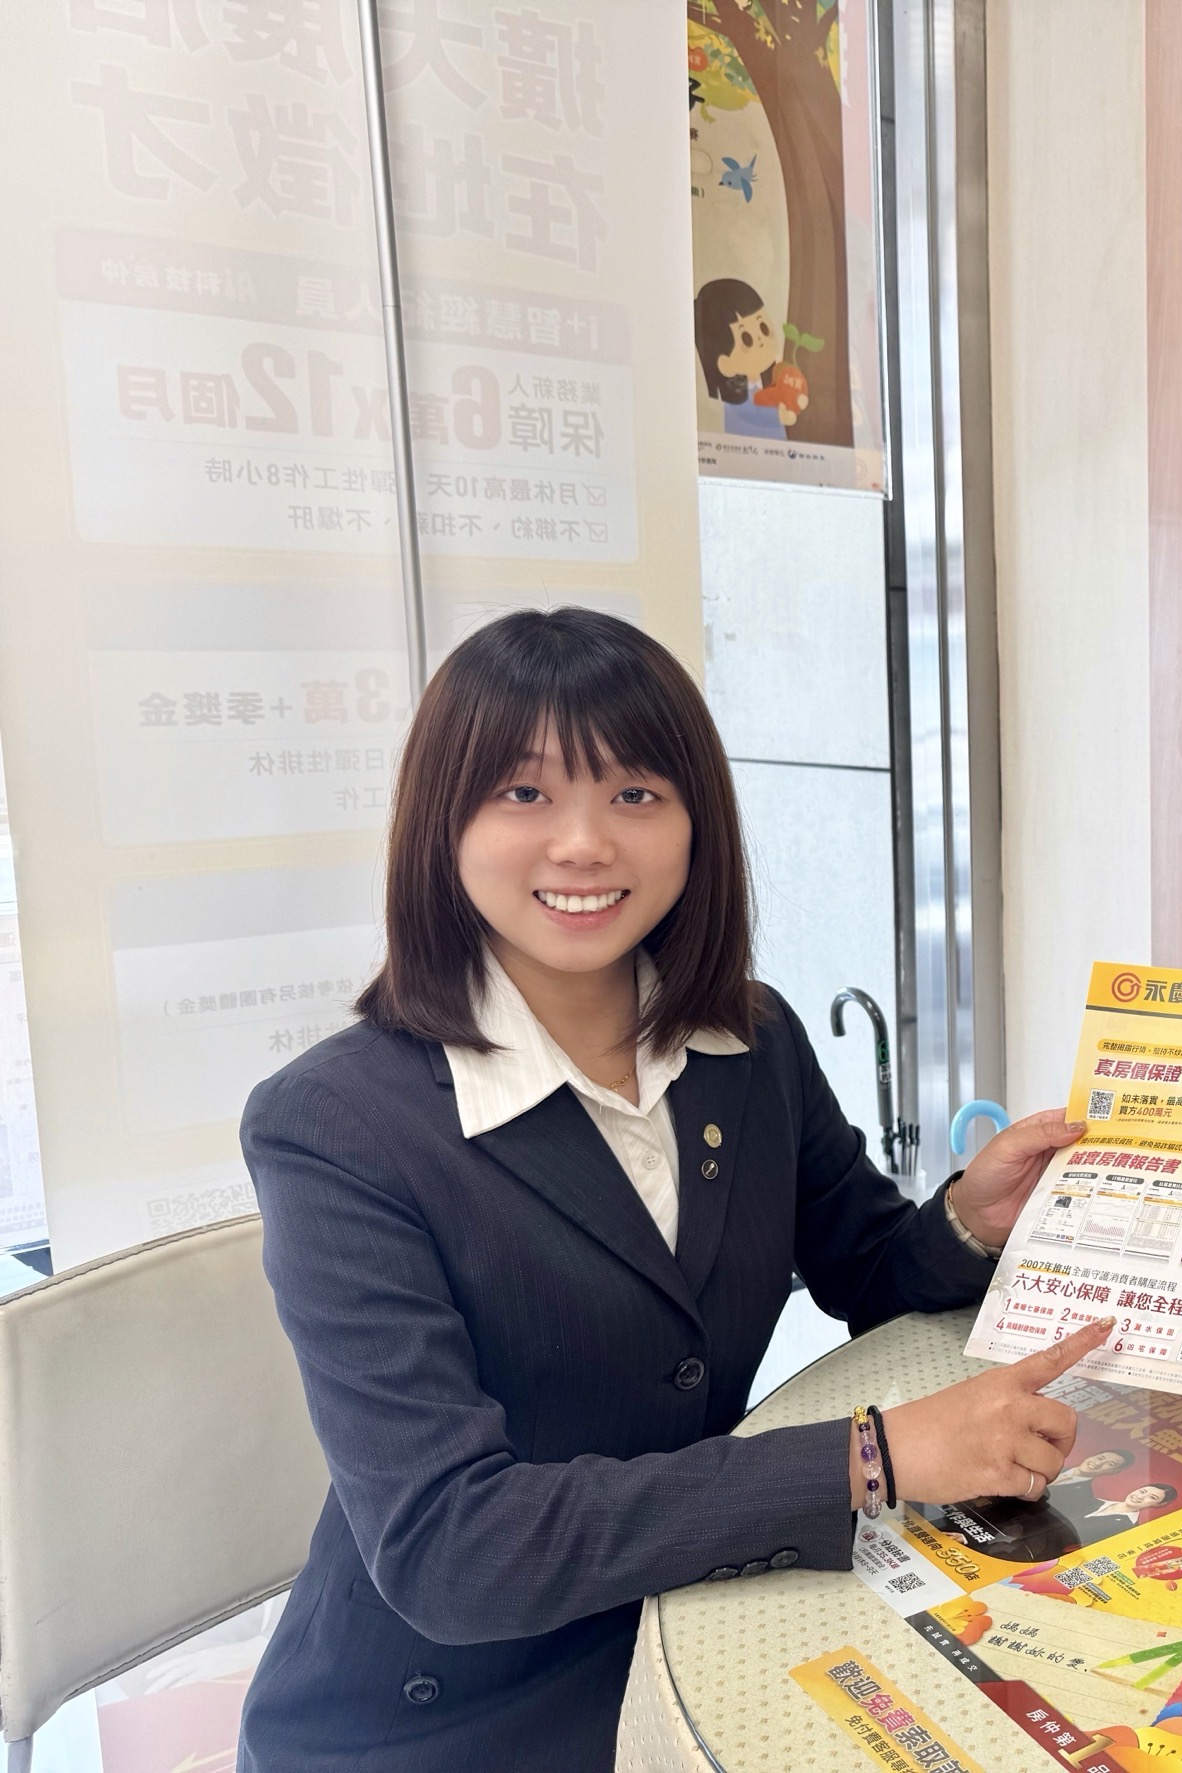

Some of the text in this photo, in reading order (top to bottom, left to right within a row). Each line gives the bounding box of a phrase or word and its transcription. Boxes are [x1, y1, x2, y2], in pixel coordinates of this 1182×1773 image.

[1118, 1105, 1173, 1118] 買方400萬元
[1067, 1150, 1182, 1174] 誠實房價報告書
[1011, 1272, 1111, 1305] 六大安心保障
